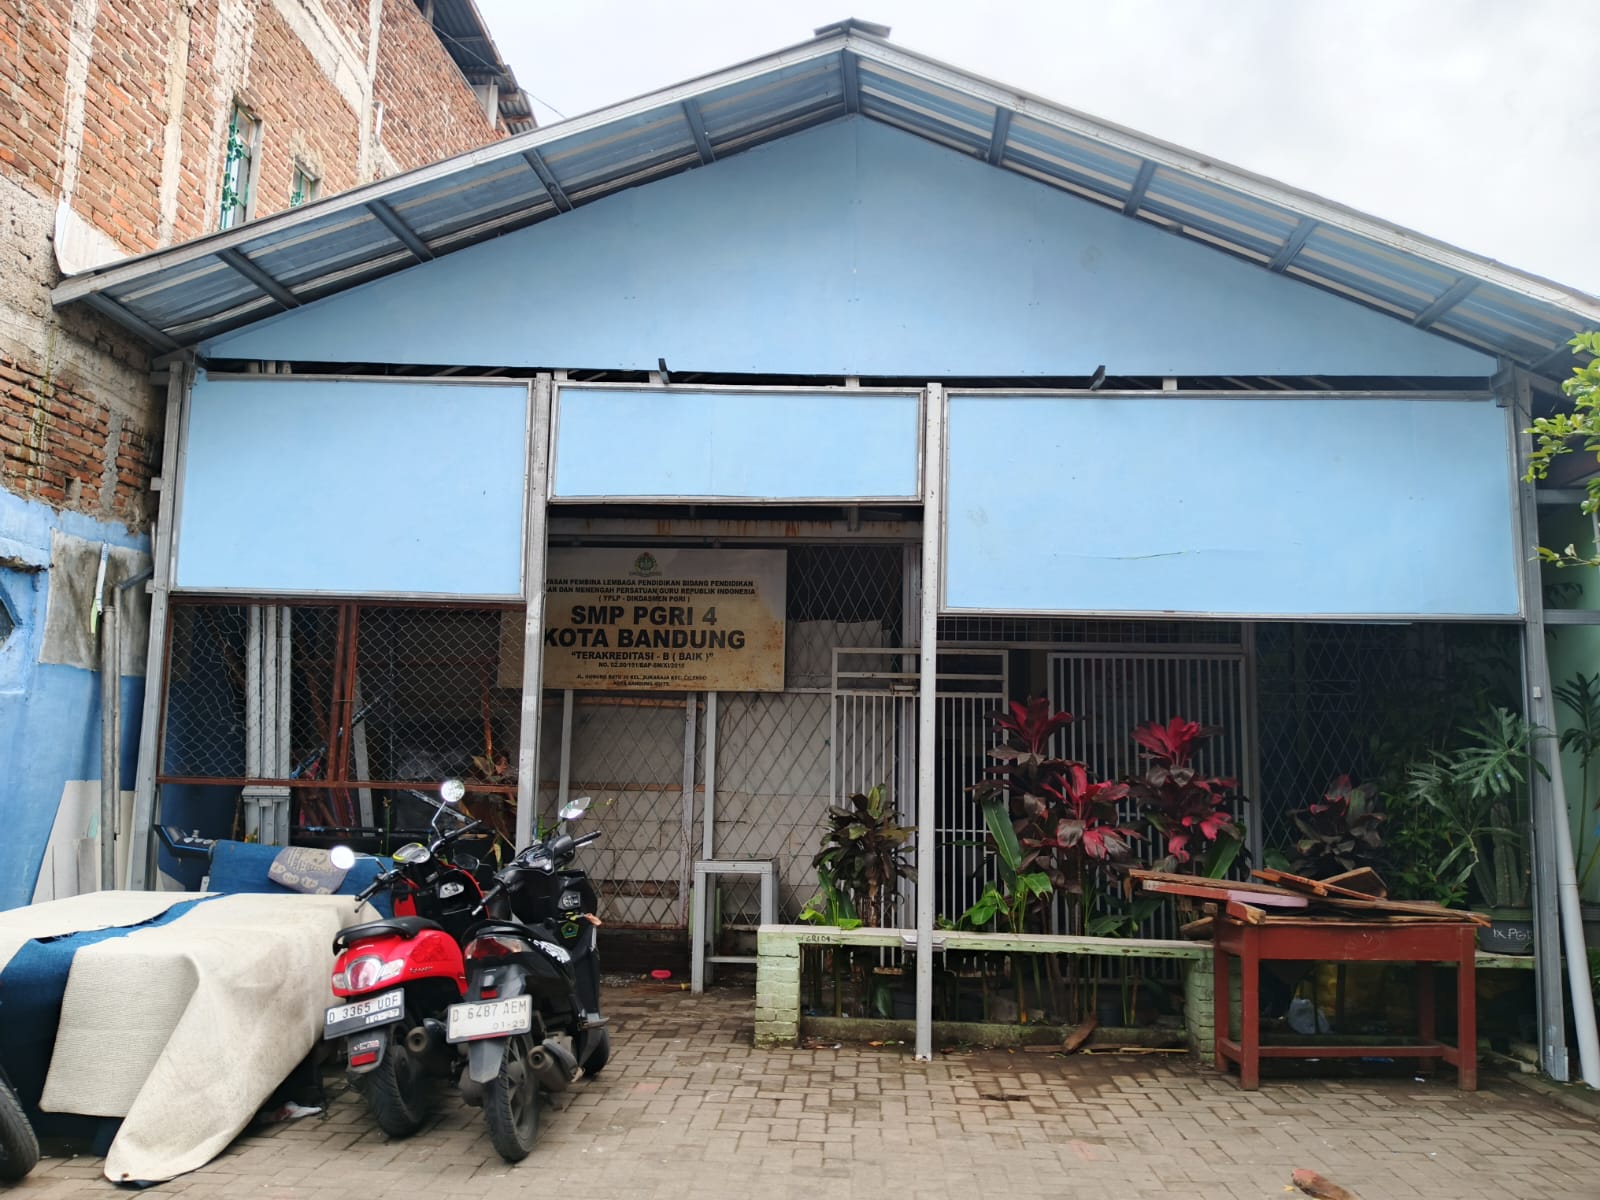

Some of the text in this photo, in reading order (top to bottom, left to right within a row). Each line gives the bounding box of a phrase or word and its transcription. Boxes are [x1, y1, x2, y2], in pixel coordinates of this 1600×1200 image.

[570, 578, 601, 586] PEMBINA
[603, 578, 636, 586] LEMBAGA
[638, 579, 681, 587] PENDIDIKAN
[575, 586, 614, 594] MENENGAH
[626, 595, 667, 603] DIKDASMEN
[570, 605, 718, 626] SMP PGRI 4
[544, 628, 746, 649] KOTA BANDUNG
[662, 651, 669, 661] B
[678, 652, 703, 662] BAIK
[329, 1012, 335, 1024] D
[342, 1002, 371, 1019] 3365
[452, 1000, 527, 1022] D 6487 AEM
[492, 1019, 526, 1031] 01-29
